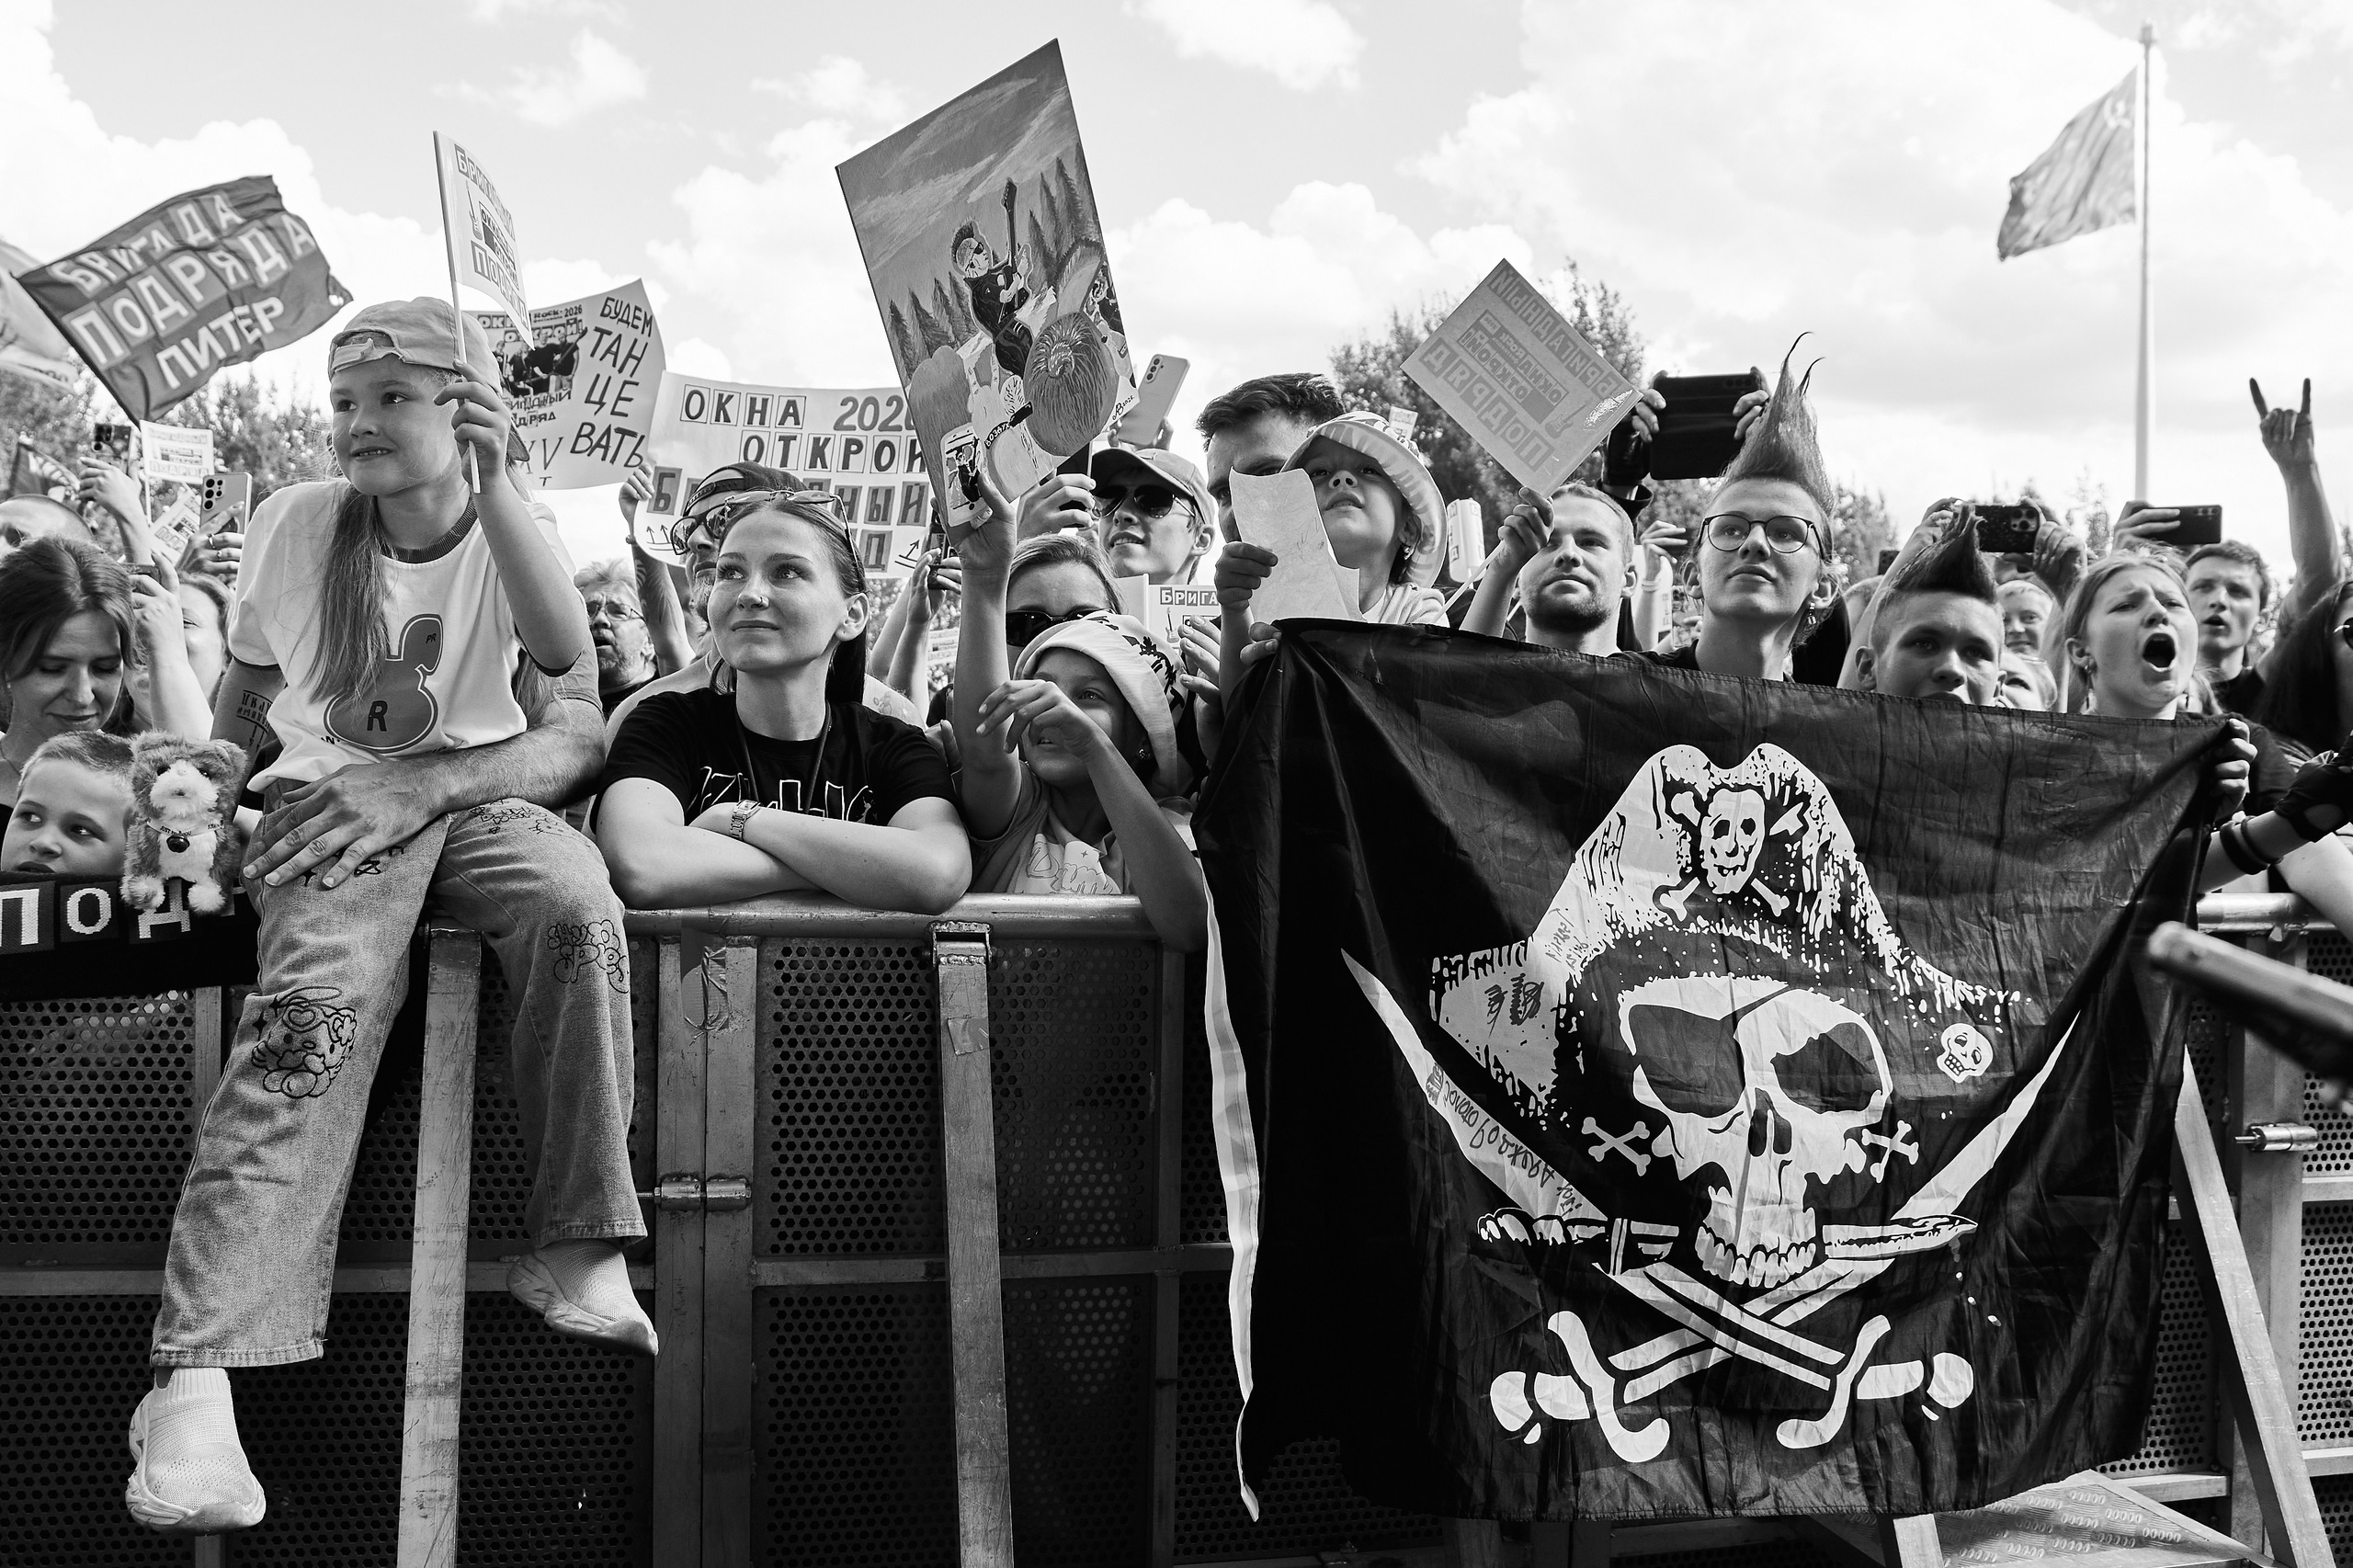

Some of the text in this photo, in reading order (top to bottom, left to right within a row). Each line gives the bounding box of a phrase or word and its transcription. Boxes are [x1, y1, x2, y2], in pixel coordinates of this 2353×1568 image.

[51, 194, 244, 291] БРИГАДА
[71, 214, 314, 367] ПОДРЯДА
[477, 313, 520, 330] ОКН
[505, 317, 584, 343] ОКРОЙ!
[563, 304, 583, 318] 2026
[600, 297, 654, 337] БУДЕМ
[155, 296, 284, 390] ПИТЕР
[590, 326, 649, 378] ТАН
[585, 373, 640, 417] ЦЕ
[684, 389, 802, 426] ОКНА
[570, 422, 645, 468] ВАТЬ
[1161, 589, 1219, 605] БРИГА
[367, 699, 388, 732] R
